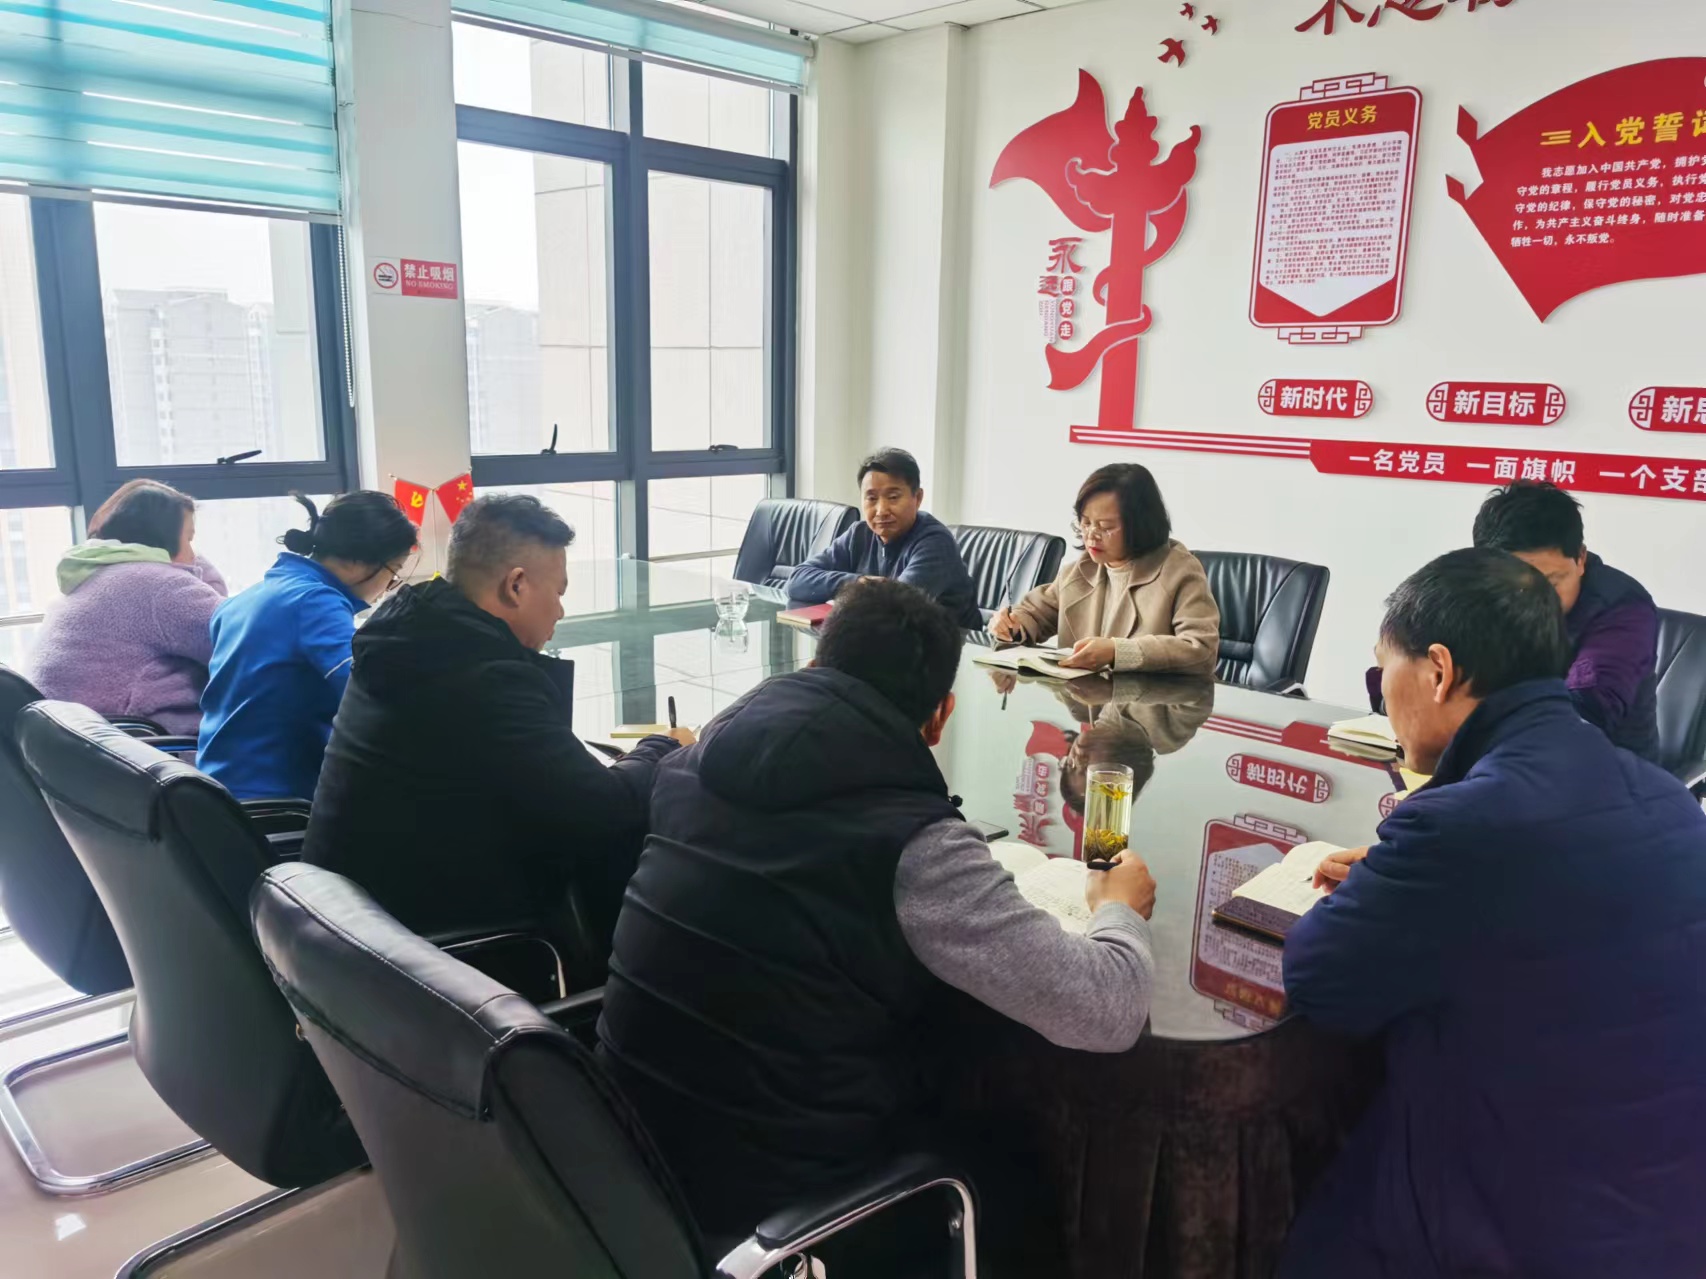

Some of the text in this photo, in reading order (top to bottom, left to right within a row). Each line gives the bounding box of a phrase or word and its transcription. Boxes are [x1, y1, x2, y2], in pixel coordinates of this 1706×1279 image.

[1307, 104, 1378, 131] 党员义务
[404, 263, 455, 282] 禁止吸烟
[405, 280, 454, 289] NO SMOKING
[1280, 385, 1348, 411] 新时代
[1453, 389, 1536, 416] 新目标
[1349, 448, 1445, 475] 一名党员
[1467, 456, 1576, 484] 一面旗帜
